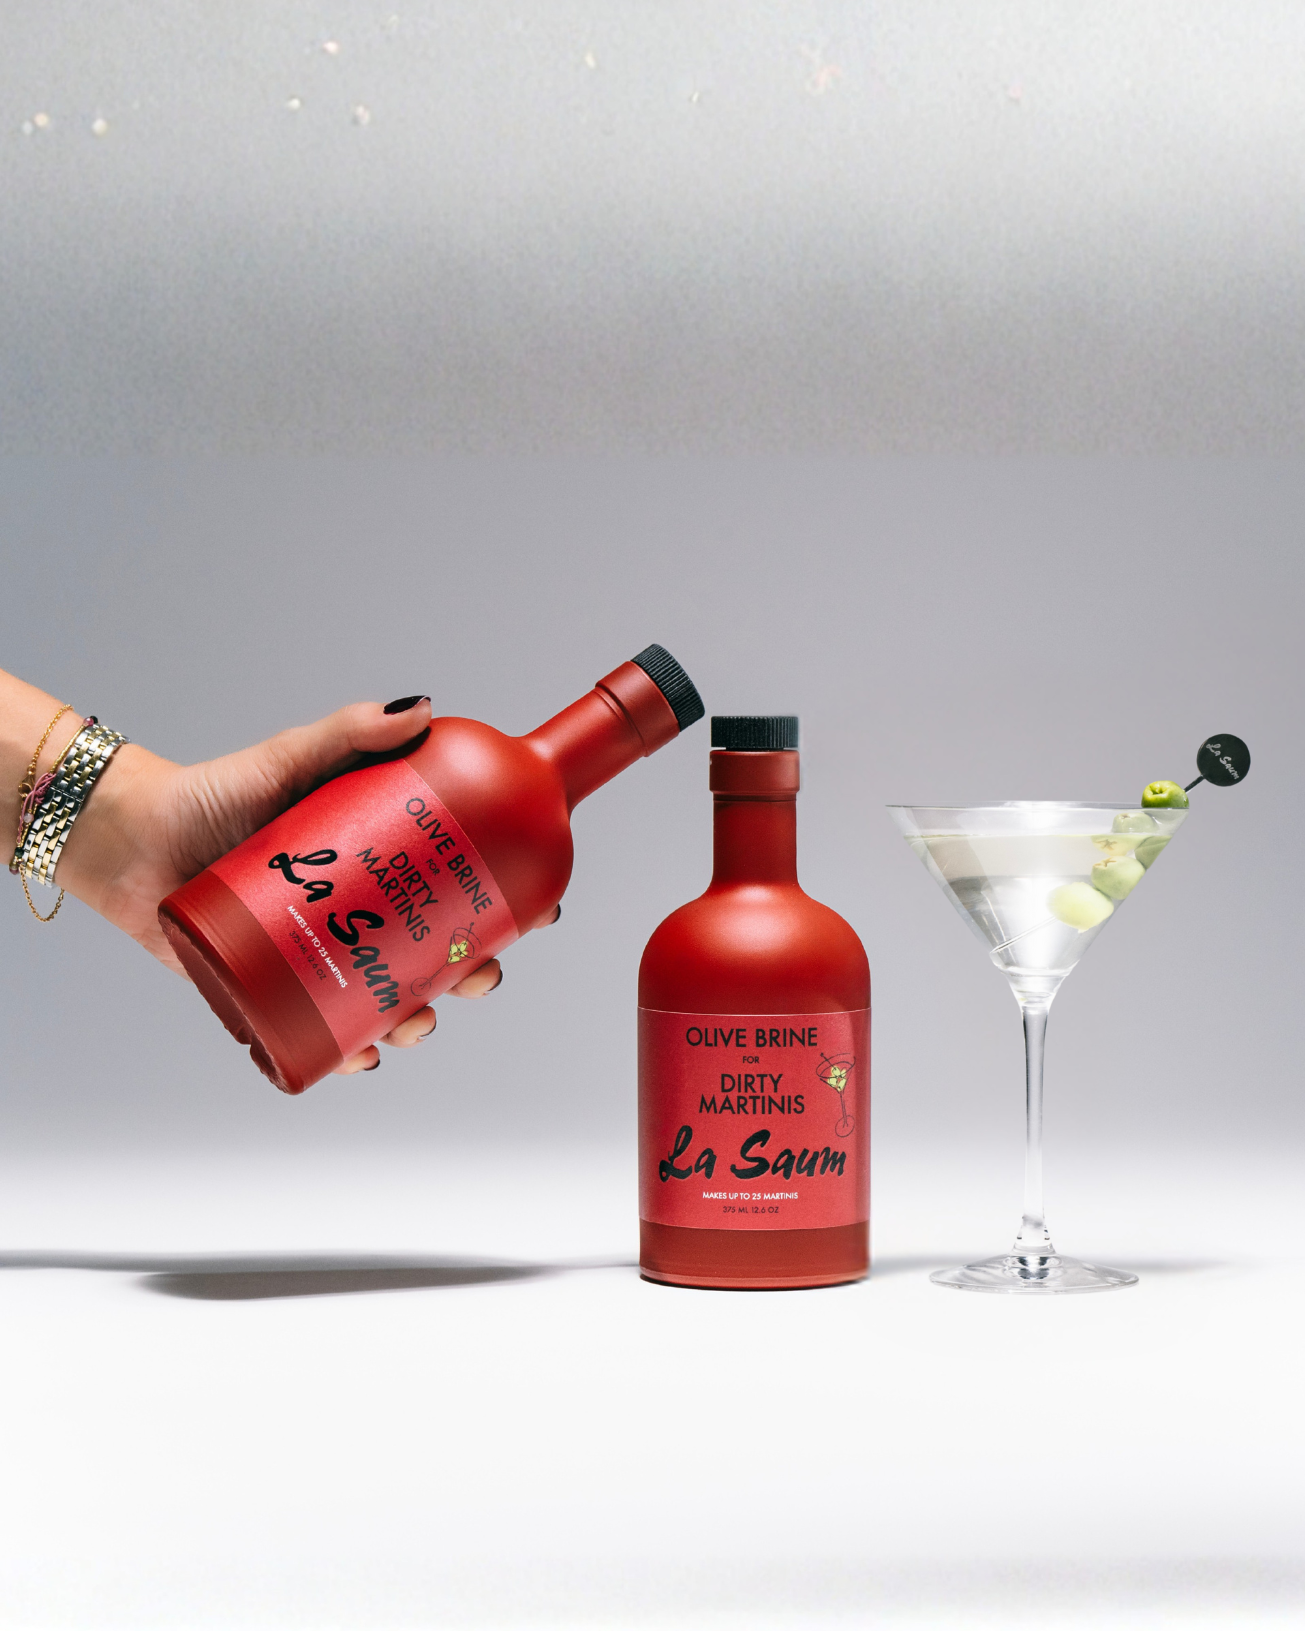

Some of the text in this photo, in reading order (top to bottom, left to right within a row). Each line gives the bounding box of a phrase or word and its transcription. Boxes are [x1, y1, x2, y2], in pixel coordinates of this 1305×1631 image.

[1206, 744, 1240, 780] La Saum
[389, 851, 439, 908] DIRTY
[406, 797, 493, 914] OLIVE BRINE
[426, 858, 440, 876] FOR
[356, 847, 431, 942] MARTINIS
[268, 849, 400, 1013] La Saum
[287, 906, 348, 988] MAKES UP TO 25 MARTINIS
[290, 930, 300, 944] 375
[298, 944, 308, 955] ML
[316, 969, 326, 980] OZ
[686, 1026, 818, 1048] OLIVE BRINE
[742, 1056, 760, 1064] FOR
[699, 1094, 805, 1115] MARTINIS
[721, 1074, 783, 1093] DIRTY
[659, 1125, 846, 1182] La Saum
